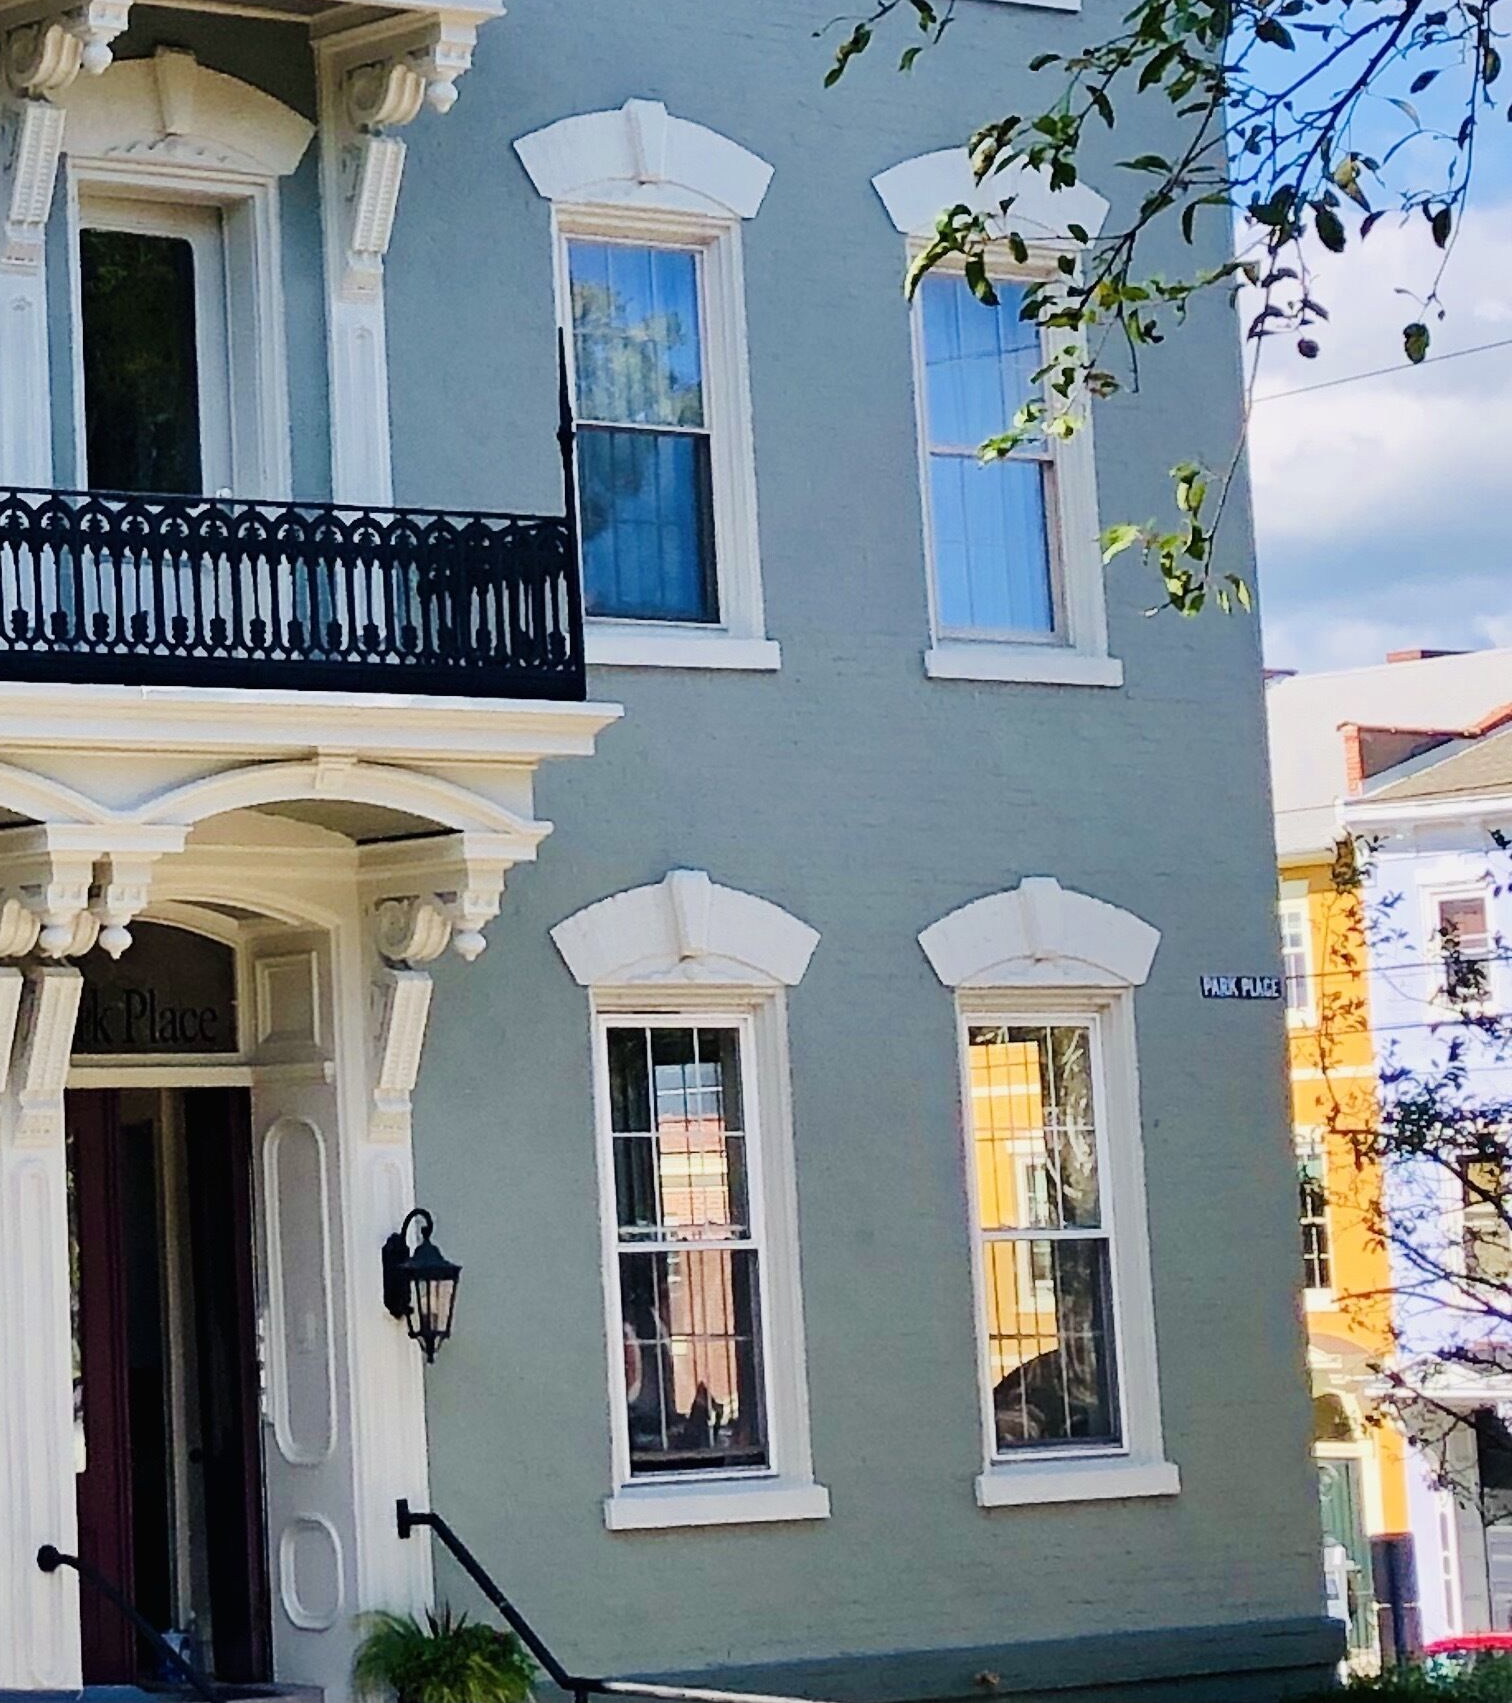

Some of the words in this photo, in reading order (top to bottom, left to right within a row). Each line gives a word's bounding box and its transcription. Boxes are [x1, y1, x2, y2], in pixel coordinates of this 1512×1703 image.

[1203, 976, 1239, 997] PARK
[1241, 977, 1280, 998] PLACE
[123, 988, 218, 1044] Place
